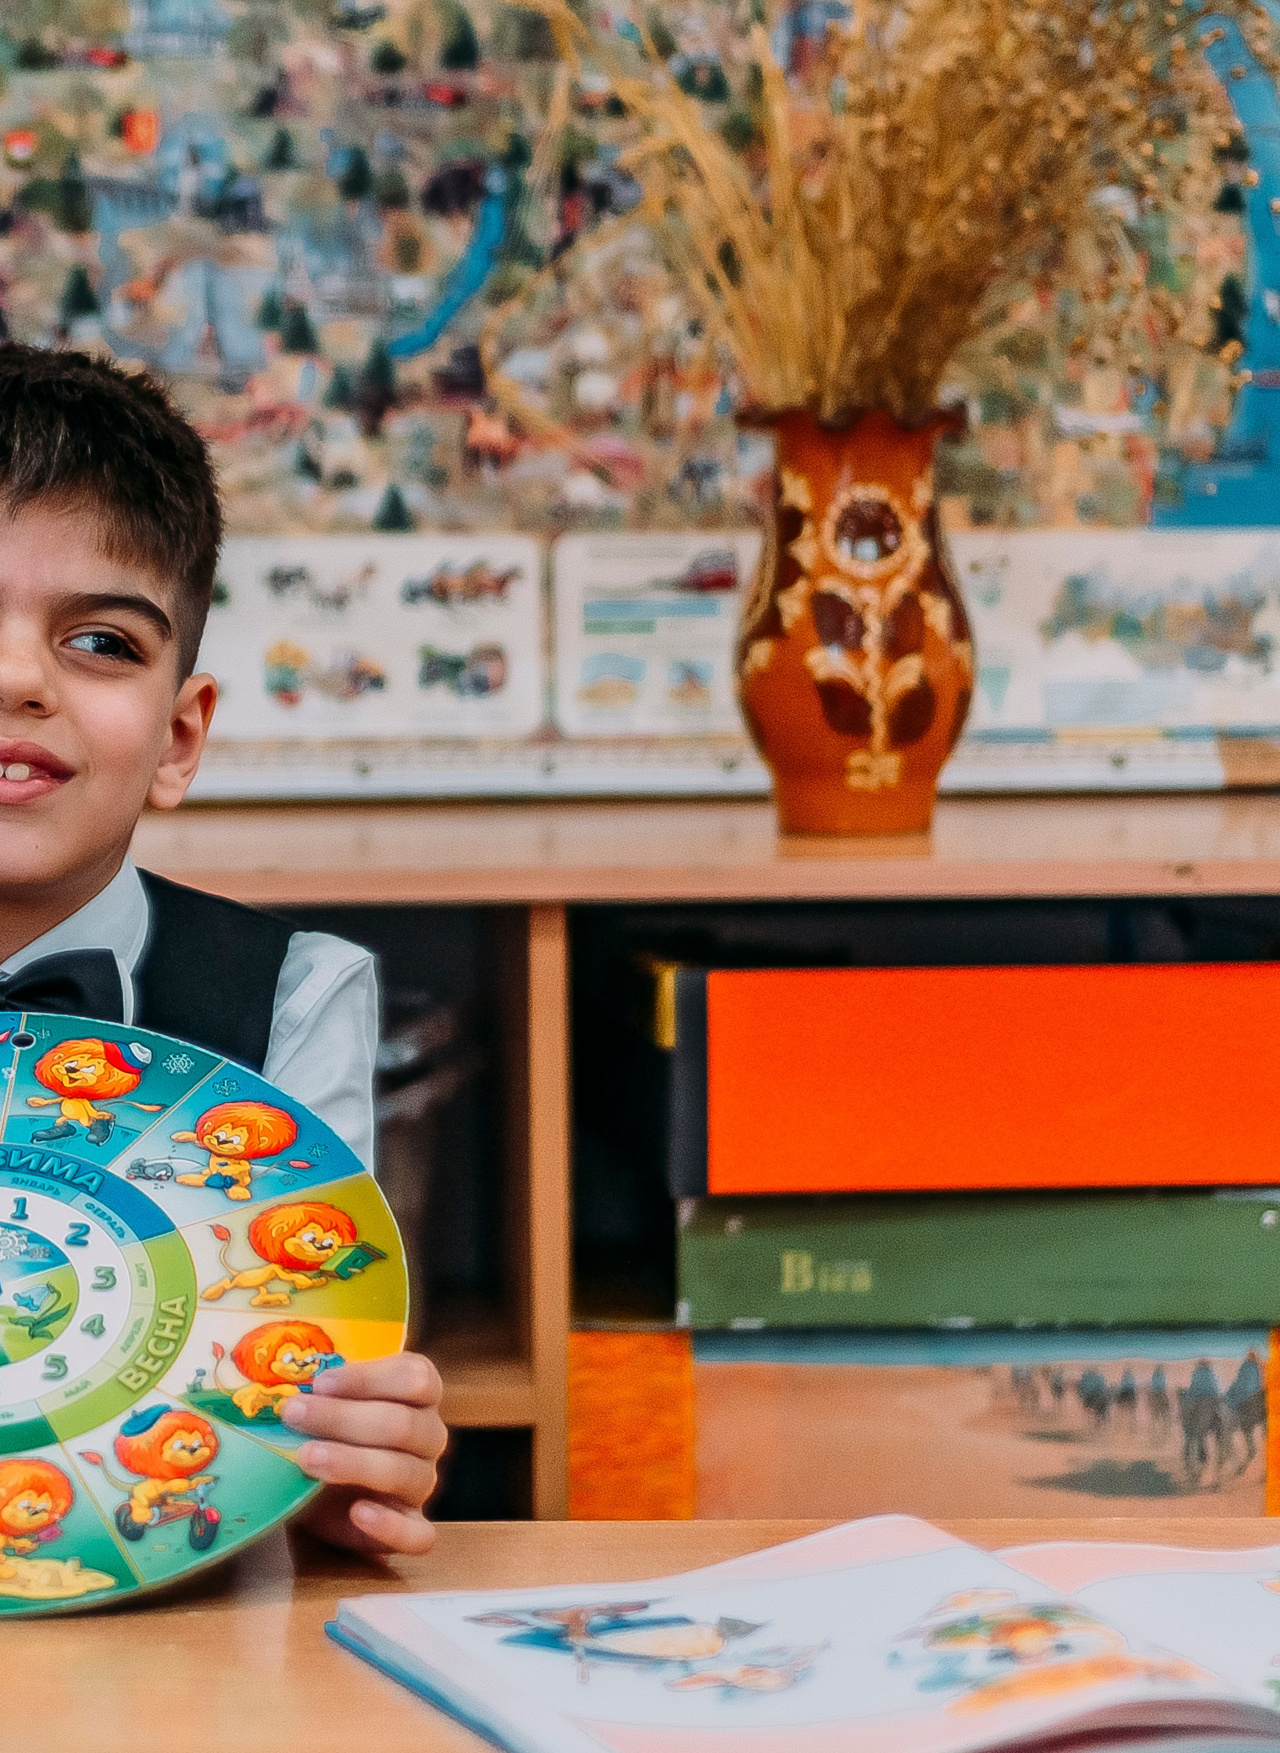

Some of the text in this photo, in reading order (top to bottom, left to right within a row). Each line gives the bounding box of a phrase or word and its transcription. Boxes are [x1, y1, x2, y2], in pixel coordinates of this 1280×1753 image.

[10, 1177, 61, 1196] ЯНВАРЬ
[10, 1196, 29, 1220] 1
[85, 1202, 127, 1239] ФЕВРАЛЬ
[65, 1222, 91, 1246] 2
[91, 1266, 117, 1290] 3
[80, 1313, 107, 1338] 4
[117, 1294, 189, 1392] ВЕСНА
[41, 1353, 68, 1380] 5
